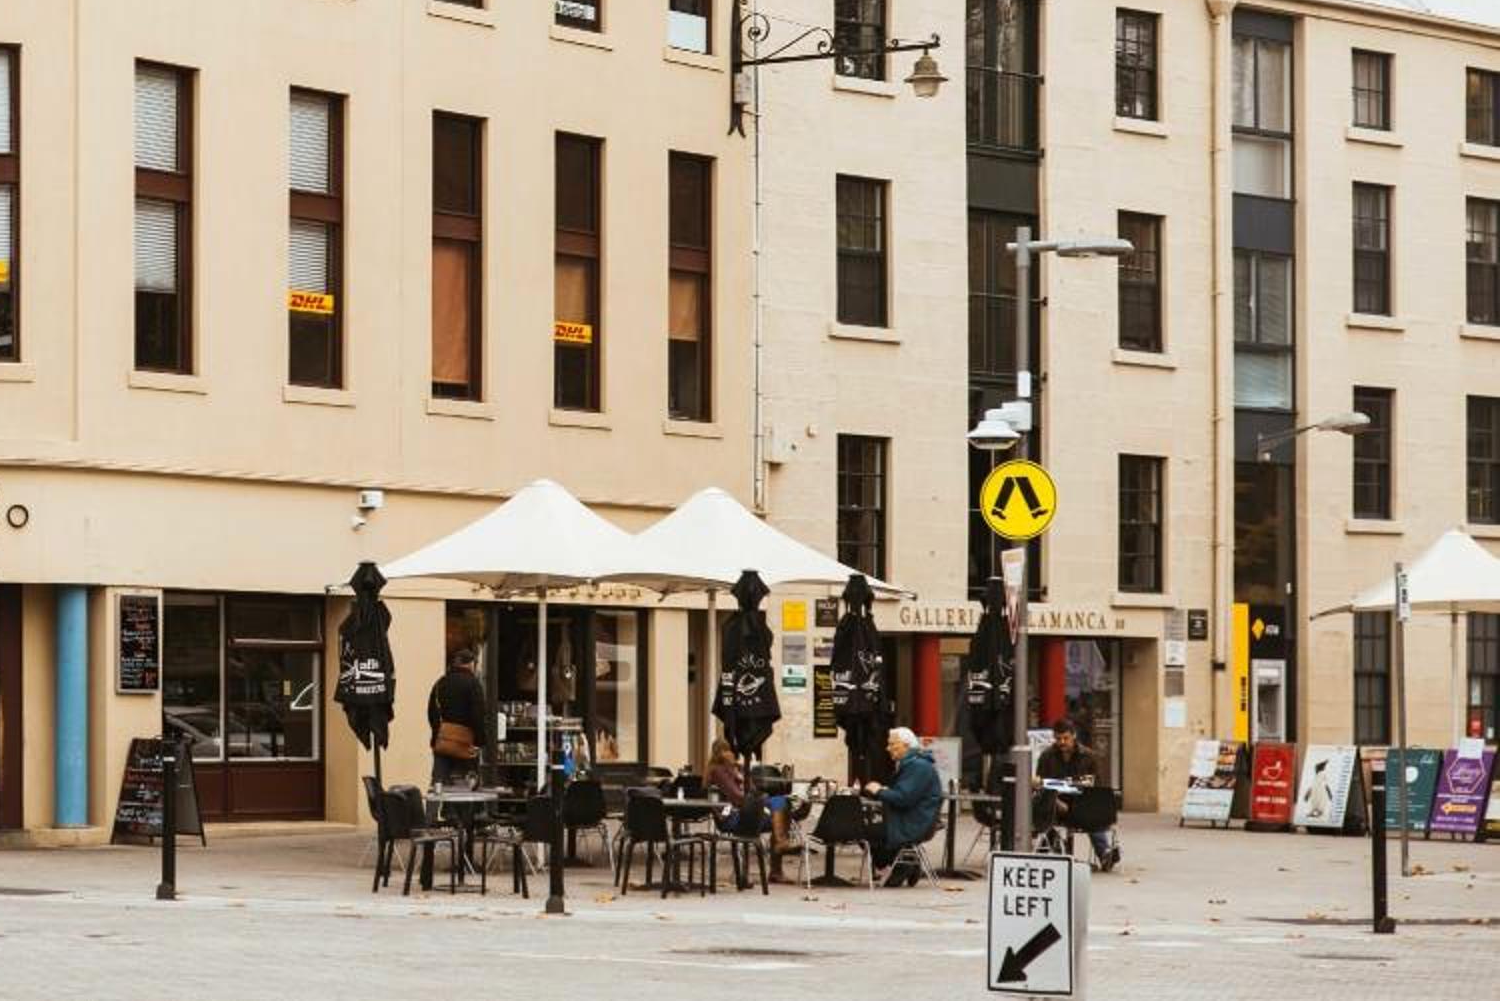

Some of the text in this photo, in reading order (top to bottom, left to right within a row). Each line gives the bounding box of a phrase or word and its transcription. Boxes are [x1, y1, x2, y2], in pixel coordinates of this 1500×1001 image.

[290, 294, 326, 310] DHL
[554, 324, 586, 340] DHL
[900, 606, 978, 627] GALLERI
[1026, 609, 1108, 630] LAMANCA
[1003, 866, 1056, 890] KEEP
[1003, 894, 1053, 918] LEFT
